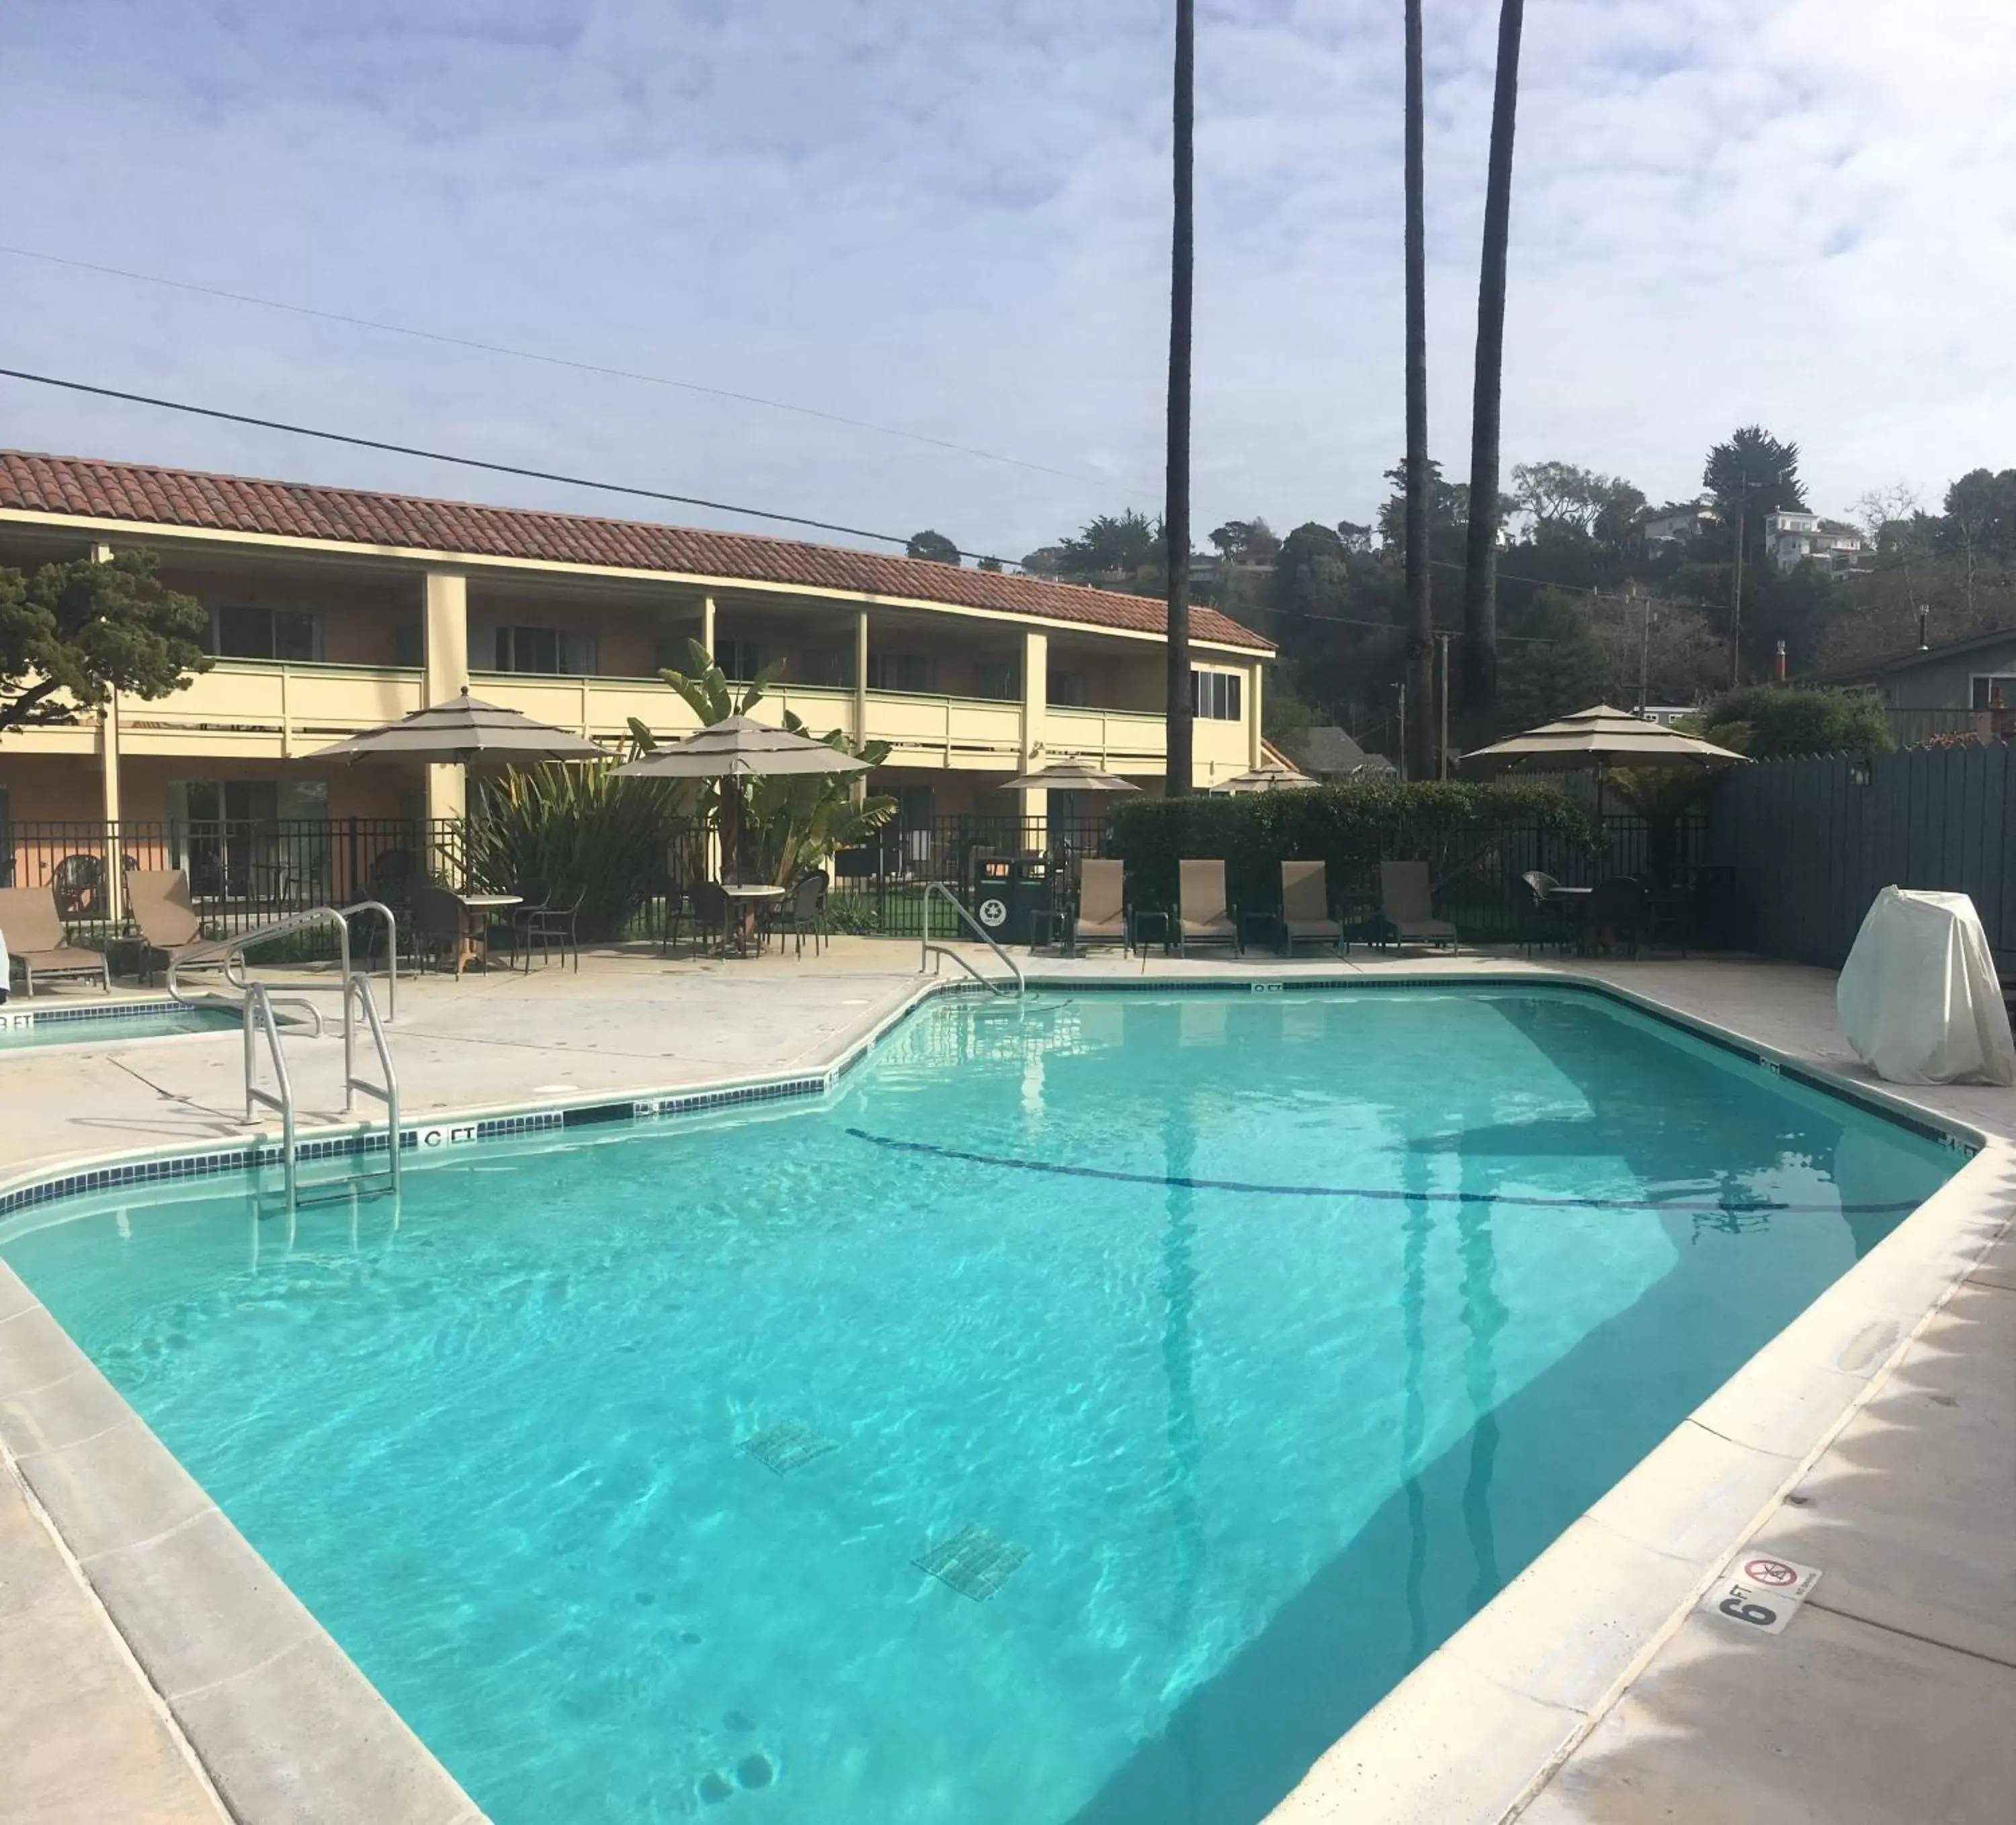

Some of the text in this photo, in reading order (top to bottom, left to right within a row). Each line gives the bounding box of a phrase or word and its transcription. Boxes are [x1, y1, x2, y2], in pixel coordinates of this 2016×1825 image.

[14, 1015, 32, 1031] FT
[1719, 1584, 1777, 1625] 6 FT
